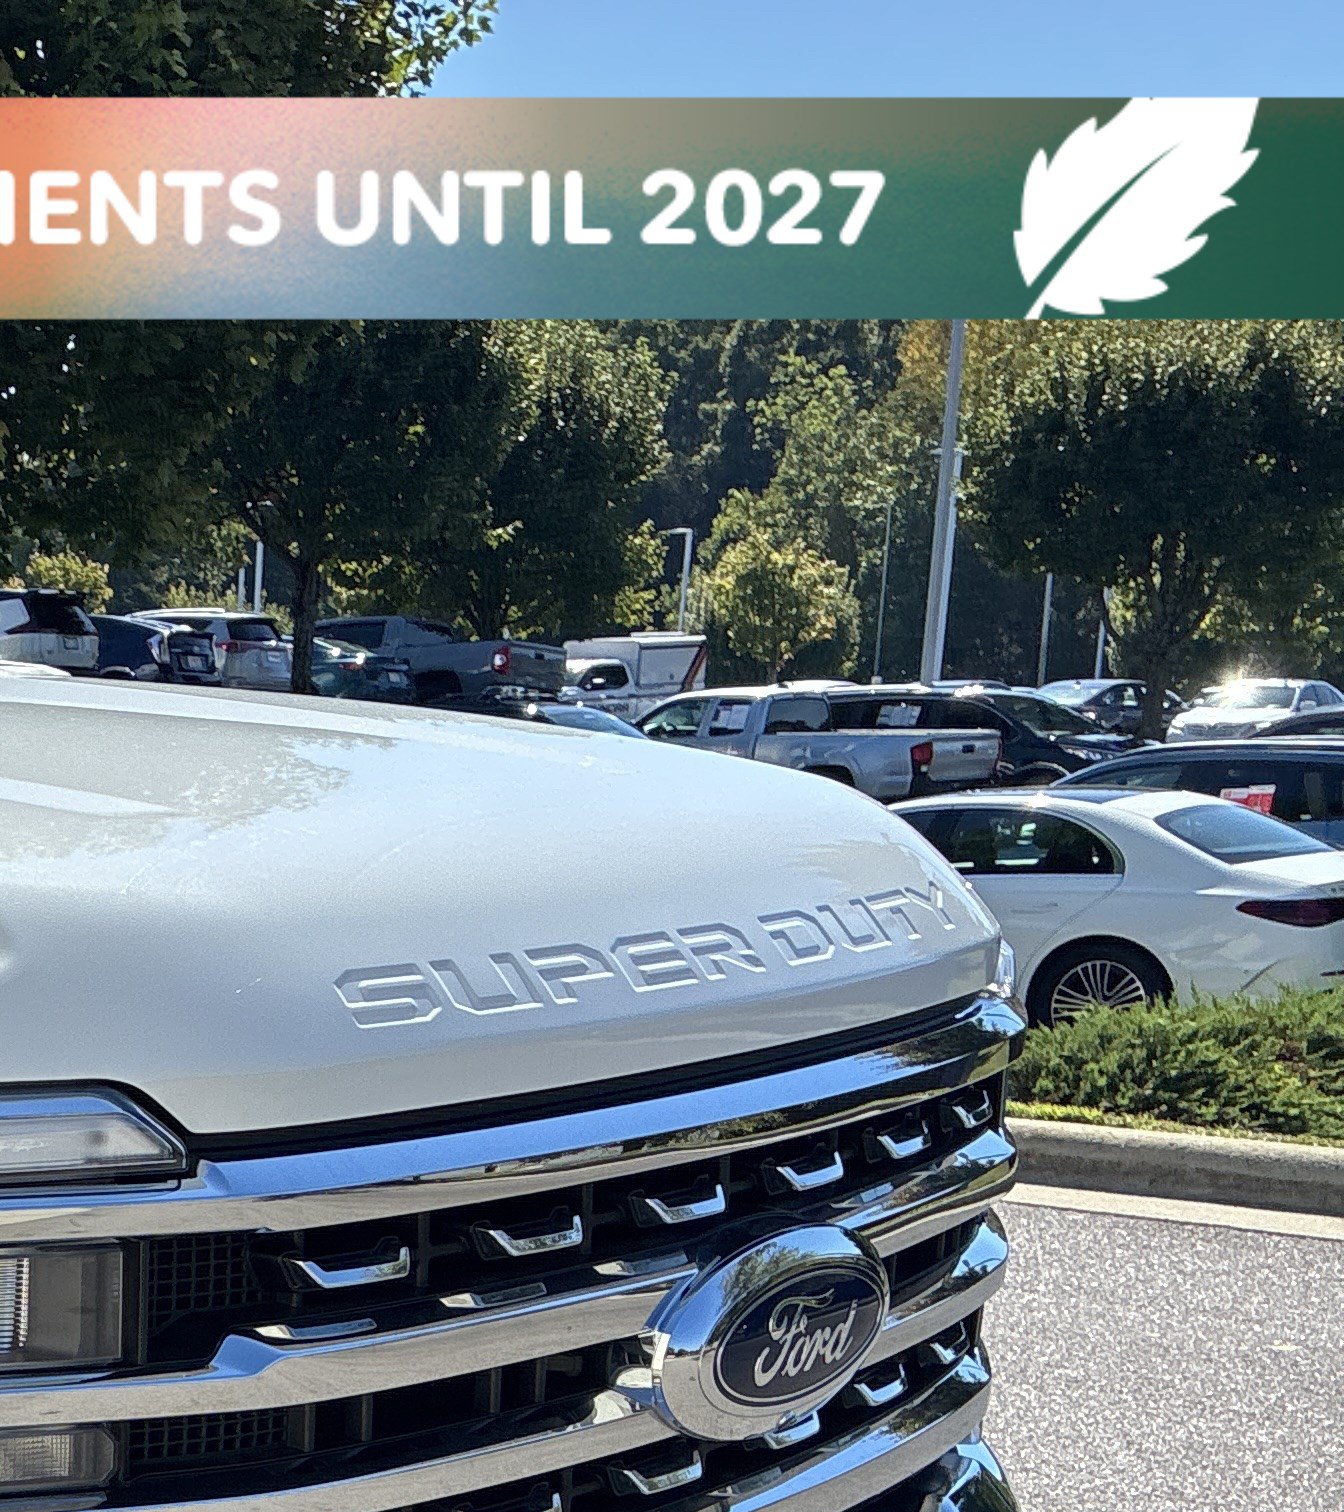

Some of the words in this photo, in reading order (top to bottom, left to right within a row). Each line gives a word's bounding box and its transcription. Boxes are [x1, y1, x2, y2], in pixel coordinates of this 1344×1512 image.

[334, 922, 766, 1028] SUPER
[757, 880, 957, 966] DUTY
[753, 1287, 859, 1388] Ford
